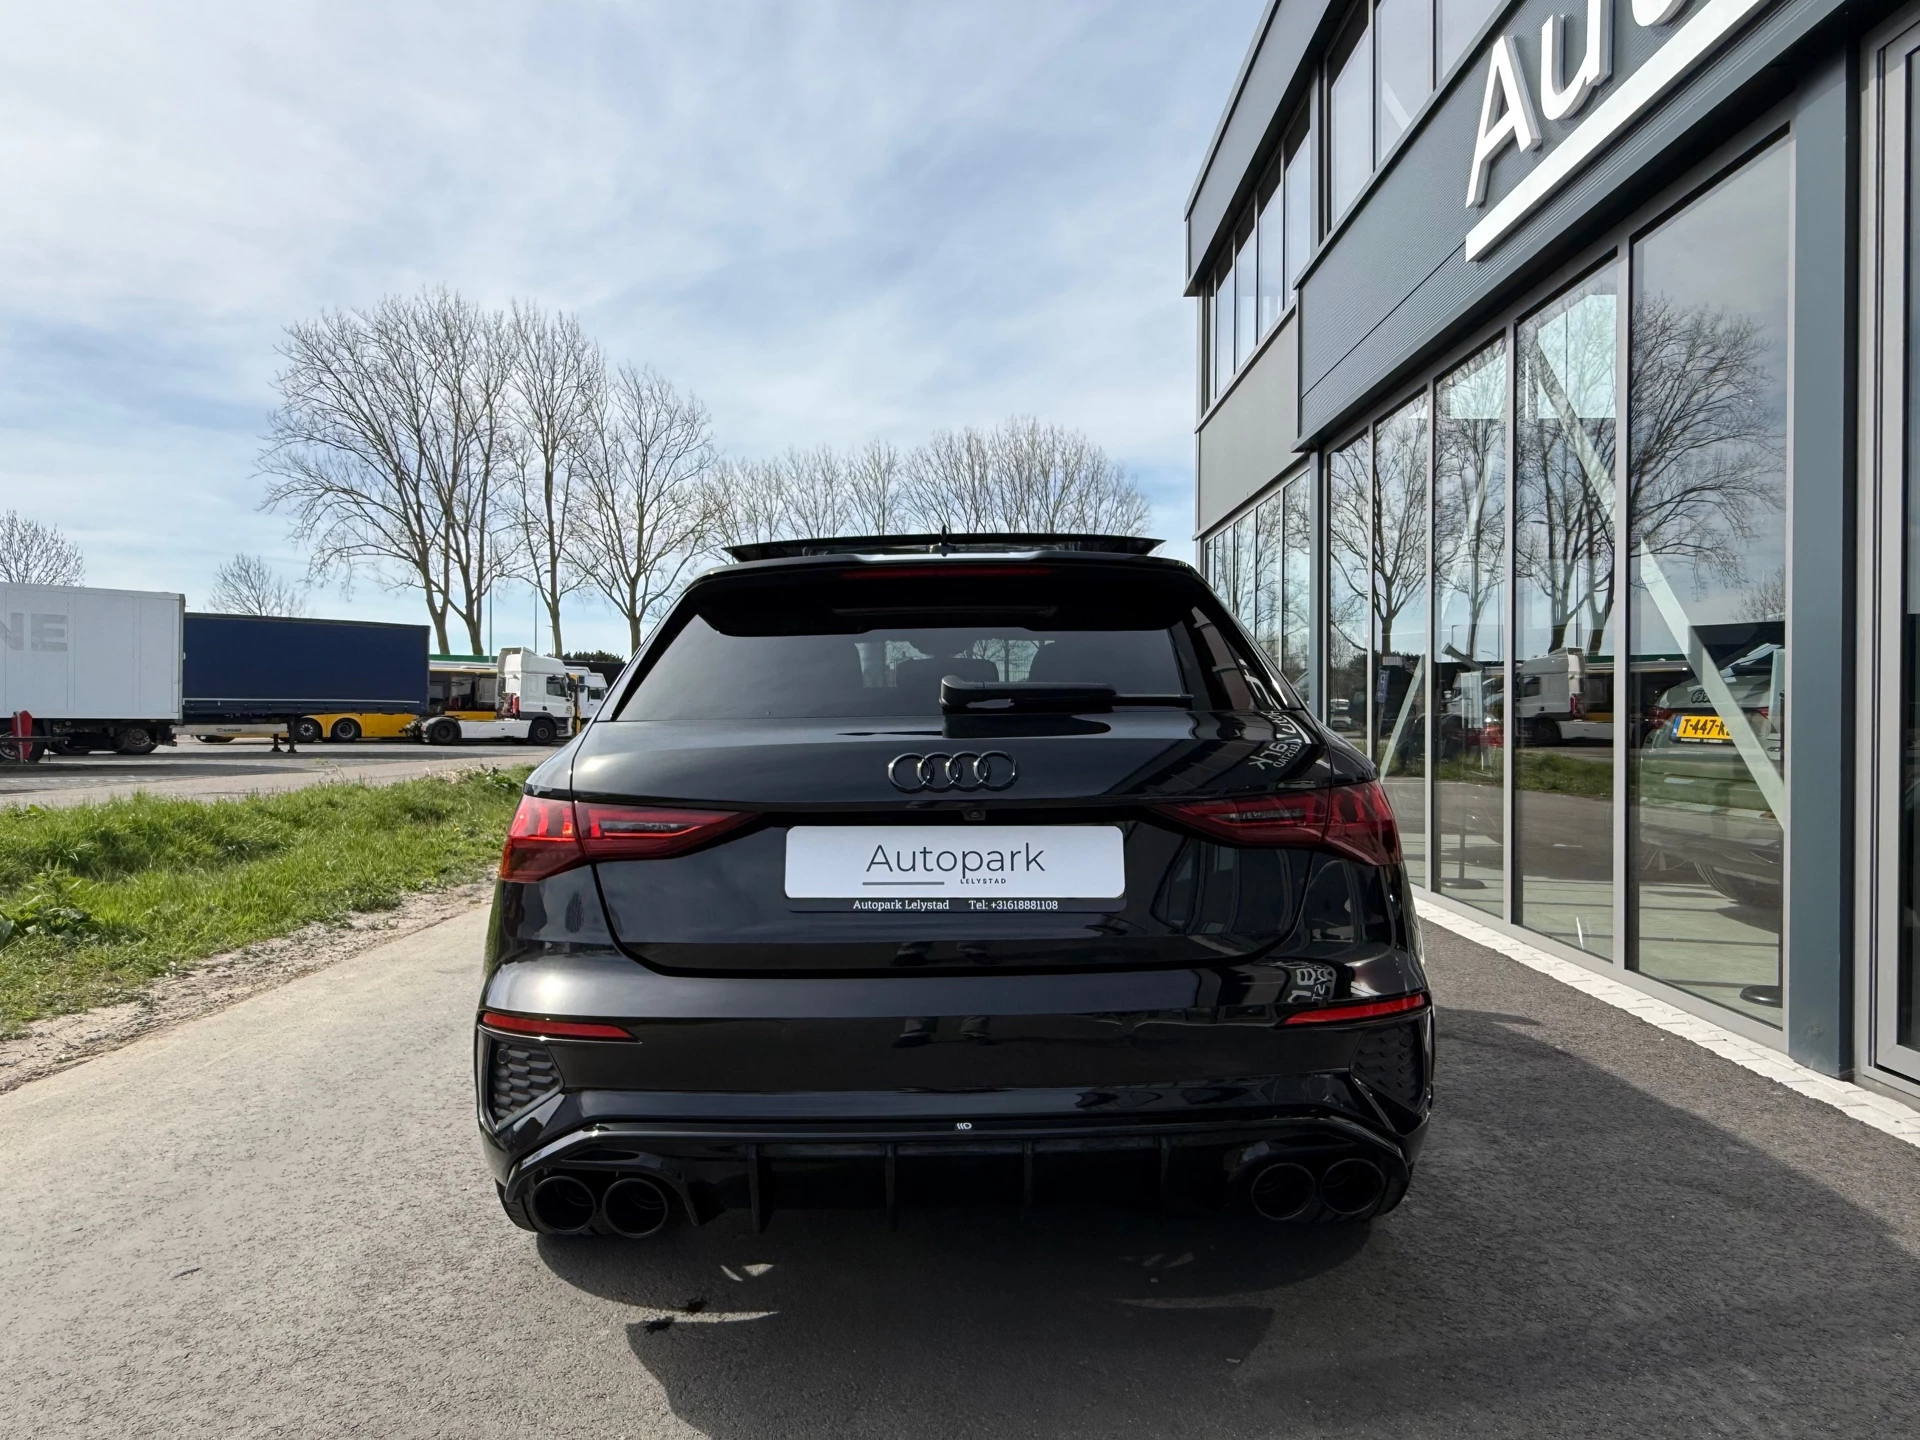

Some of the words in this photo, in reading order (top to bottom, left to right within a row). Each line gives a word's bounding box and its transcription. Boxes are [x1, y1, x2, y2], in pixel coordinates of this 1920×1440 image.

[1465, 0, 1690, 208] Au
[1682, 718, 1730, 736] T-447-K
[865, 842, 1046, 879] Autopark
[960, 877, 1007, 885] LELYSTAD
[852, 899, 903, 912] Autopark
[904, 899, 950, 912] Lelystad
[968, 899, 989, 910] Tel:
[990, 900, 1059, 910] +31618881108
